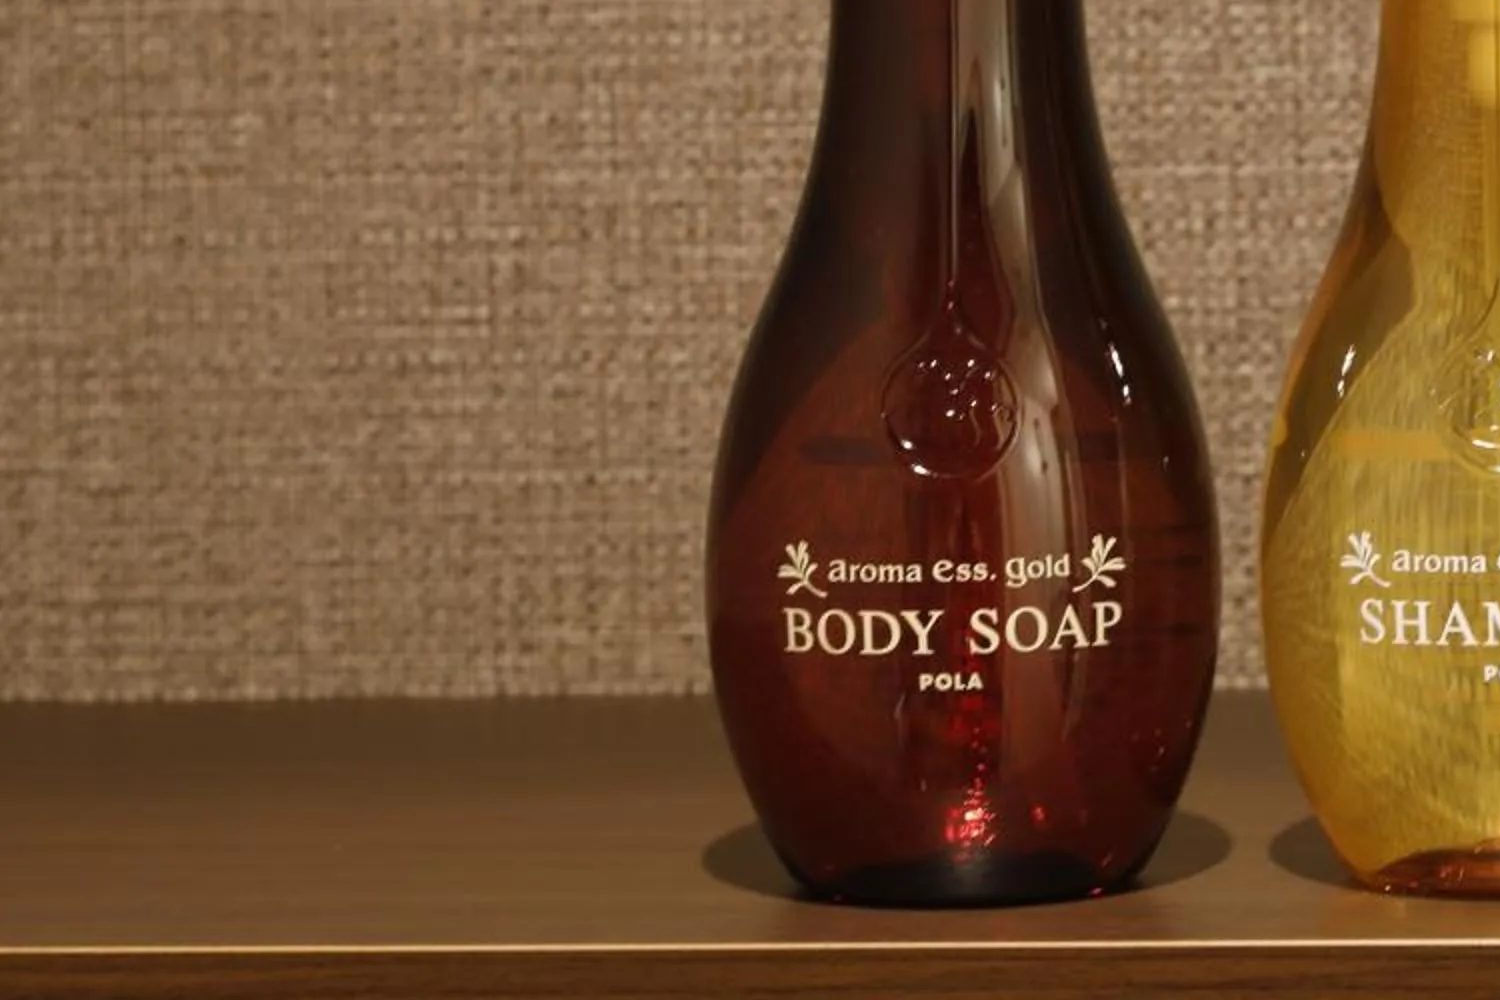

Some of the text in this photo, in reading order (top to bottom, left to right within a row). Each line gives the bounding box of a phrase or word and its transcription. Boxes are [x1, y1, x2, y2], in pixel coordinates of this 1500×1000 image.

[828, 553, 1071, 588] aroma ess. gold
[1391, 548, 1487, 573] aroma
[782, 601, 1123, 656] BODY SOAP
[919, 672, 984, 692] POLA
